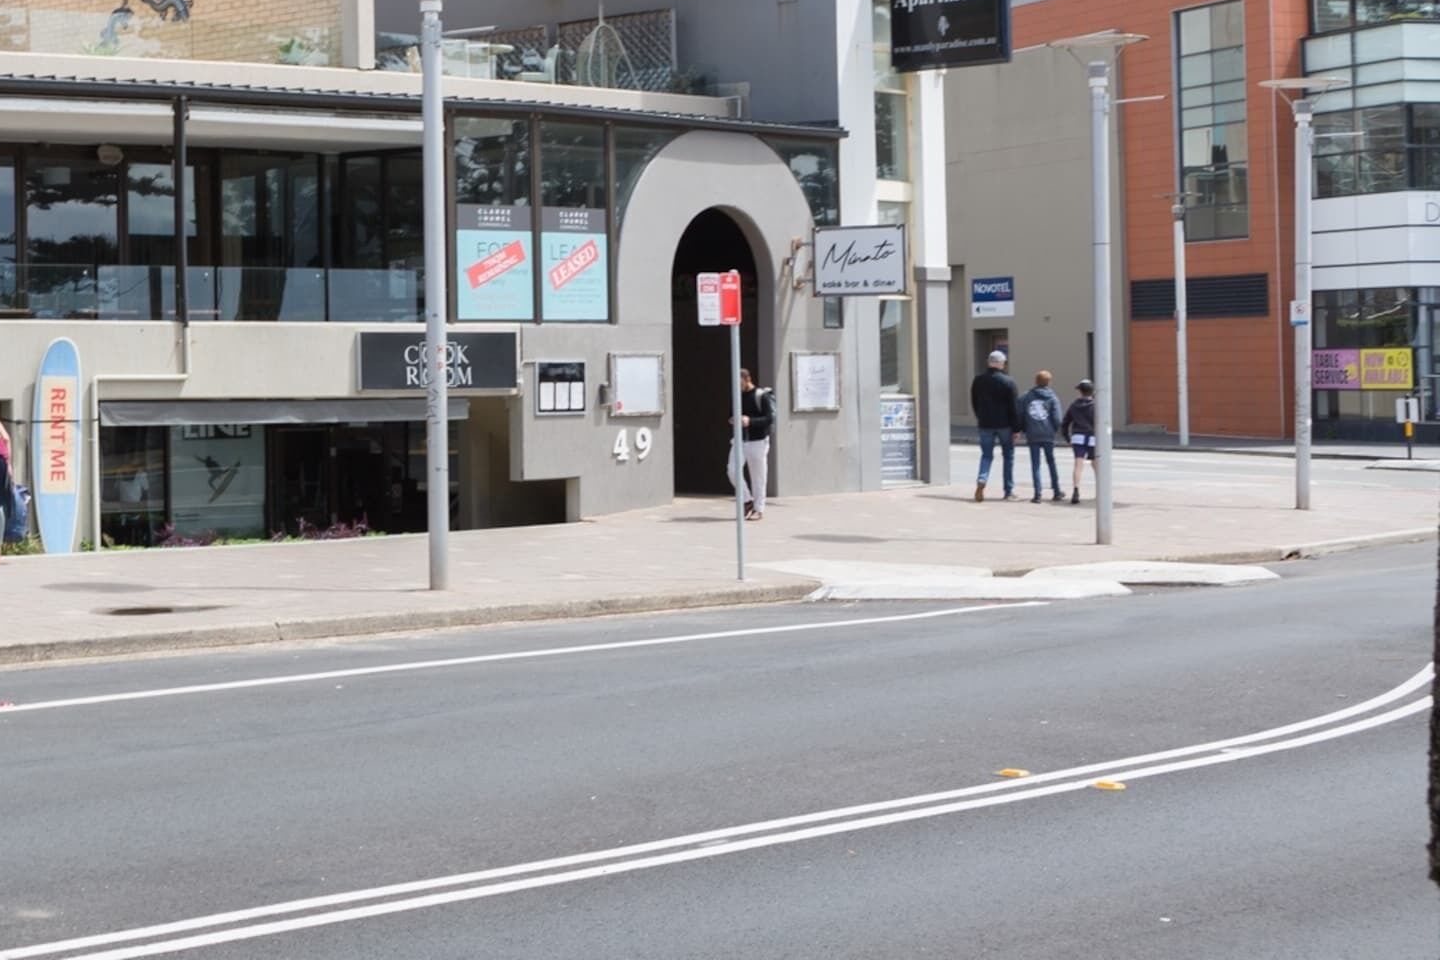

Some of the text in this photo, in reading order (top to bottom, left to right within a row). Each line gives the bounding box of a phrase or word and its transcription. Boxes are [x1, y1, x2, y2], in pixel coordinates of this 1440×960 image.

[476, 241, 510, 259] FO
[552, 245, 596, 286] LEASED
[821, 240, 896, 273] Minato
[1314, 353, 1339, 368] TABLE
[1314, 369, 1349, 385] SERVICE
[50, 387, 67, 481] RENT ME
[612, 427, 652, 461] 49
